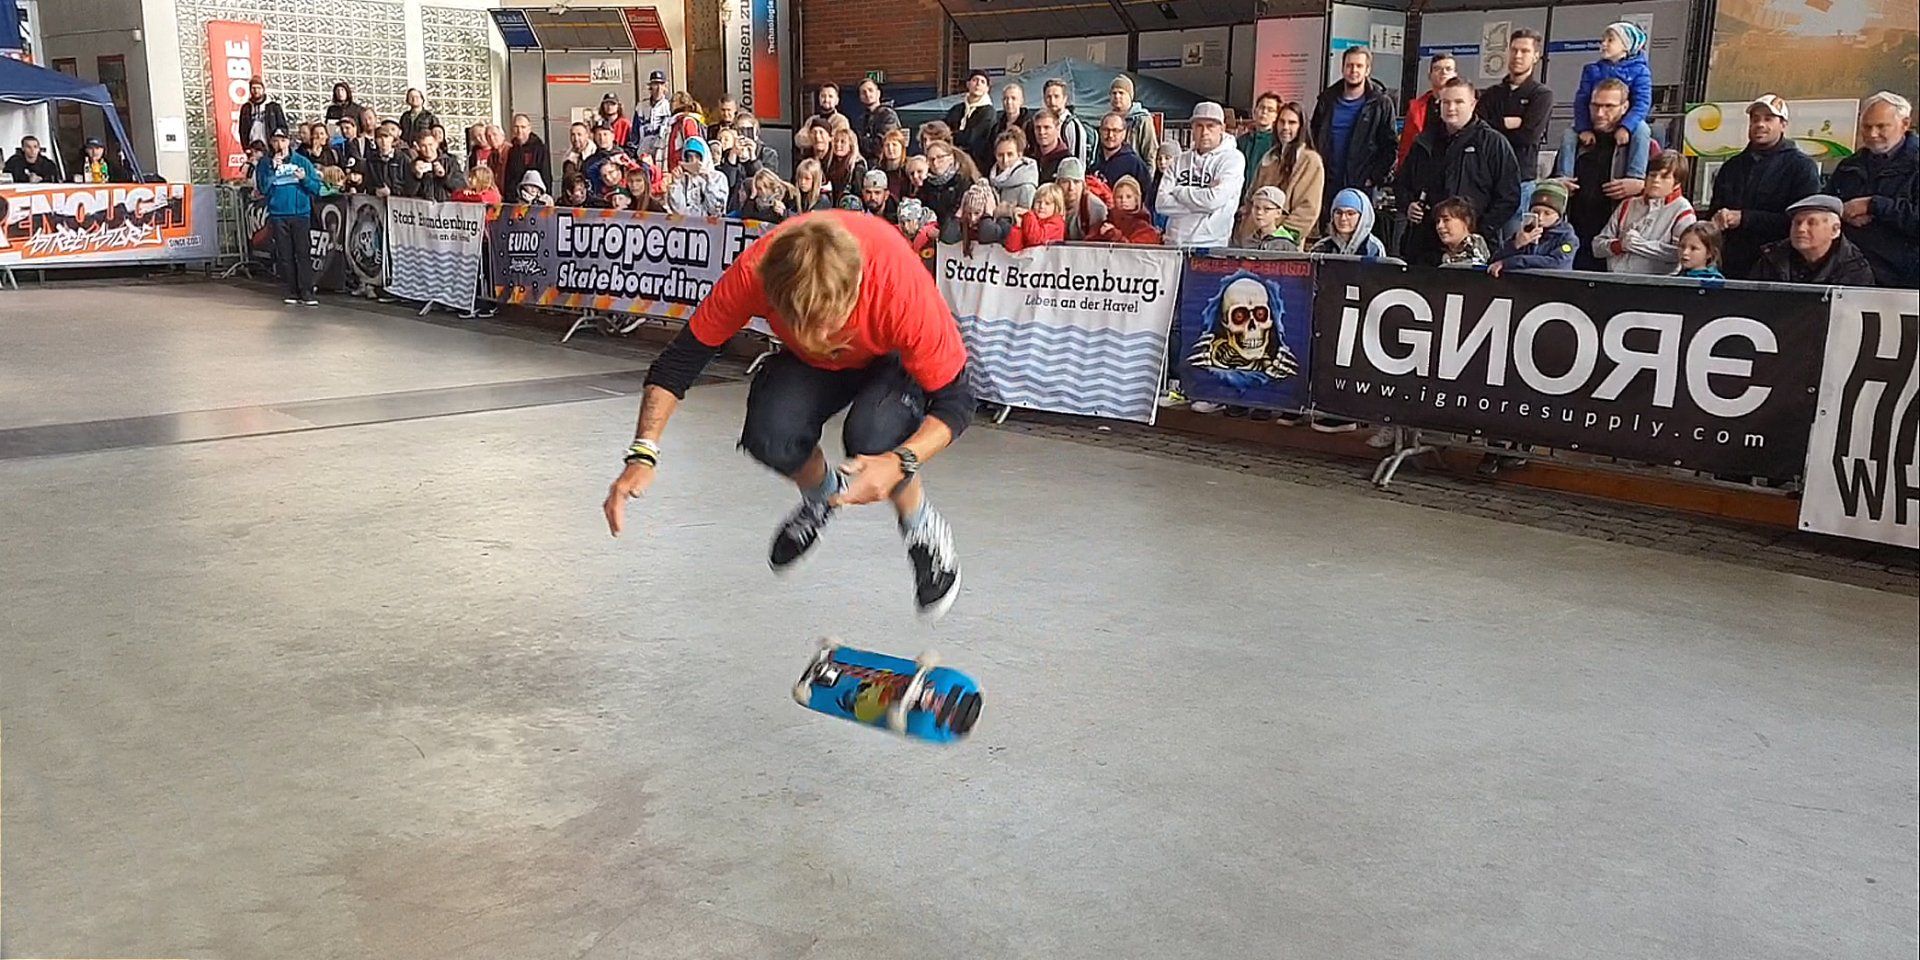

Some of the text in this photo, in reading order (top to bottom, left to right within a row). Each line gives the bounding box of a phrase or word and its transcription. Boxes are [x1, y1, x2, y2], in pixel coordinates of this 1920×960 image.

[738, 24, 752, 73] Eisen
[419, 212, 481, 236] Bndenburg.
[508, 232, 539, 251] EURO
[557, 215, 711, 268] European
[557, 262, 713, 302] Skateboarding
[945, 258, 1166, 302] Stadt Brandenburg.
[1025, 294, 1139, 313] Leben an der Havel
[1334, 376, 1765, 448] www.ignoresupply.com
